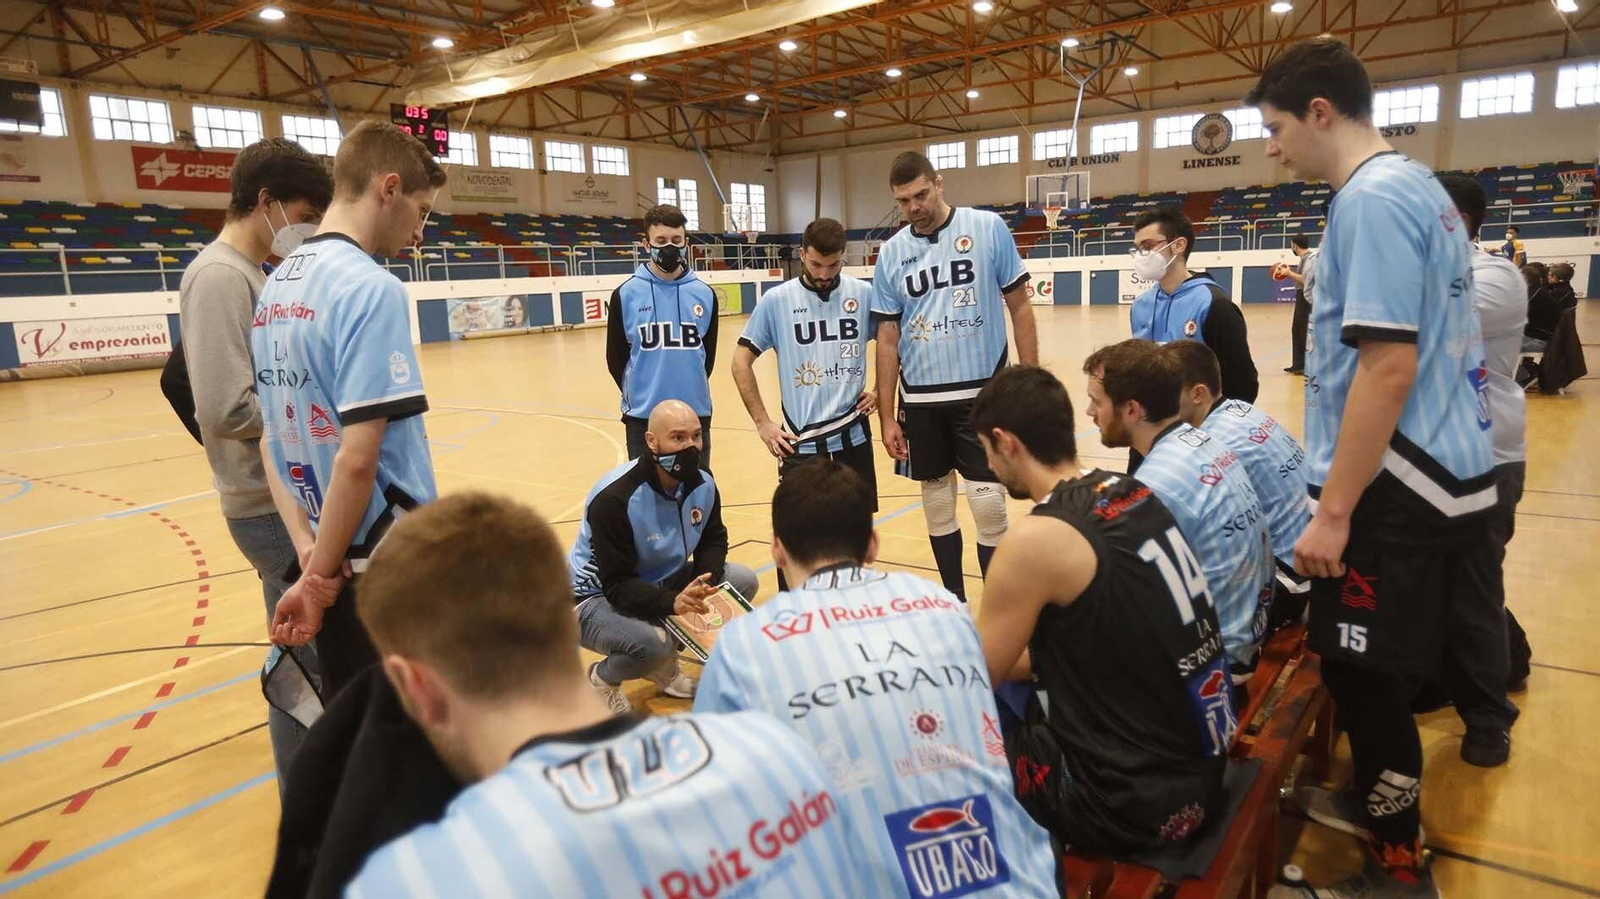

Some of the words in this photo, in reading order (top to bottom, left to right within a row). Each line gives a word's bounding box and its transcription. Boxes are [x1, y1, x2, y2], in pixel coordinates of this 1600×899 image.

[433, 129, 447, 141] 00
[1081, 153, 1119, 166] UNION
[1182, 155, 1240, 169] LINENSE
[904, 258, 977, 299] ULB
[952, 286, 977, 308] 21
[69, 333, 166, 351] empresarial
[637, 321, 703, 351] ULB
[793, 317, 860, 346] ULB
[840, 342, 861, 359] 20
[1137, 526, 1215, 626] 14
[829, 603, 886, 622] Ruiz
[890, 595, 961, 613] Galán
[1336, 622, 1368, 653] 15
[855, 641, 919, 664] LA
[788, 664, 991, 719] SERRANA
[543, 717, 713, 814] ULB
[1367, 783, 1420, 816] adida
[660, 849, 751, 899] Ruiz
[749, 788, 838, 860] Galán
